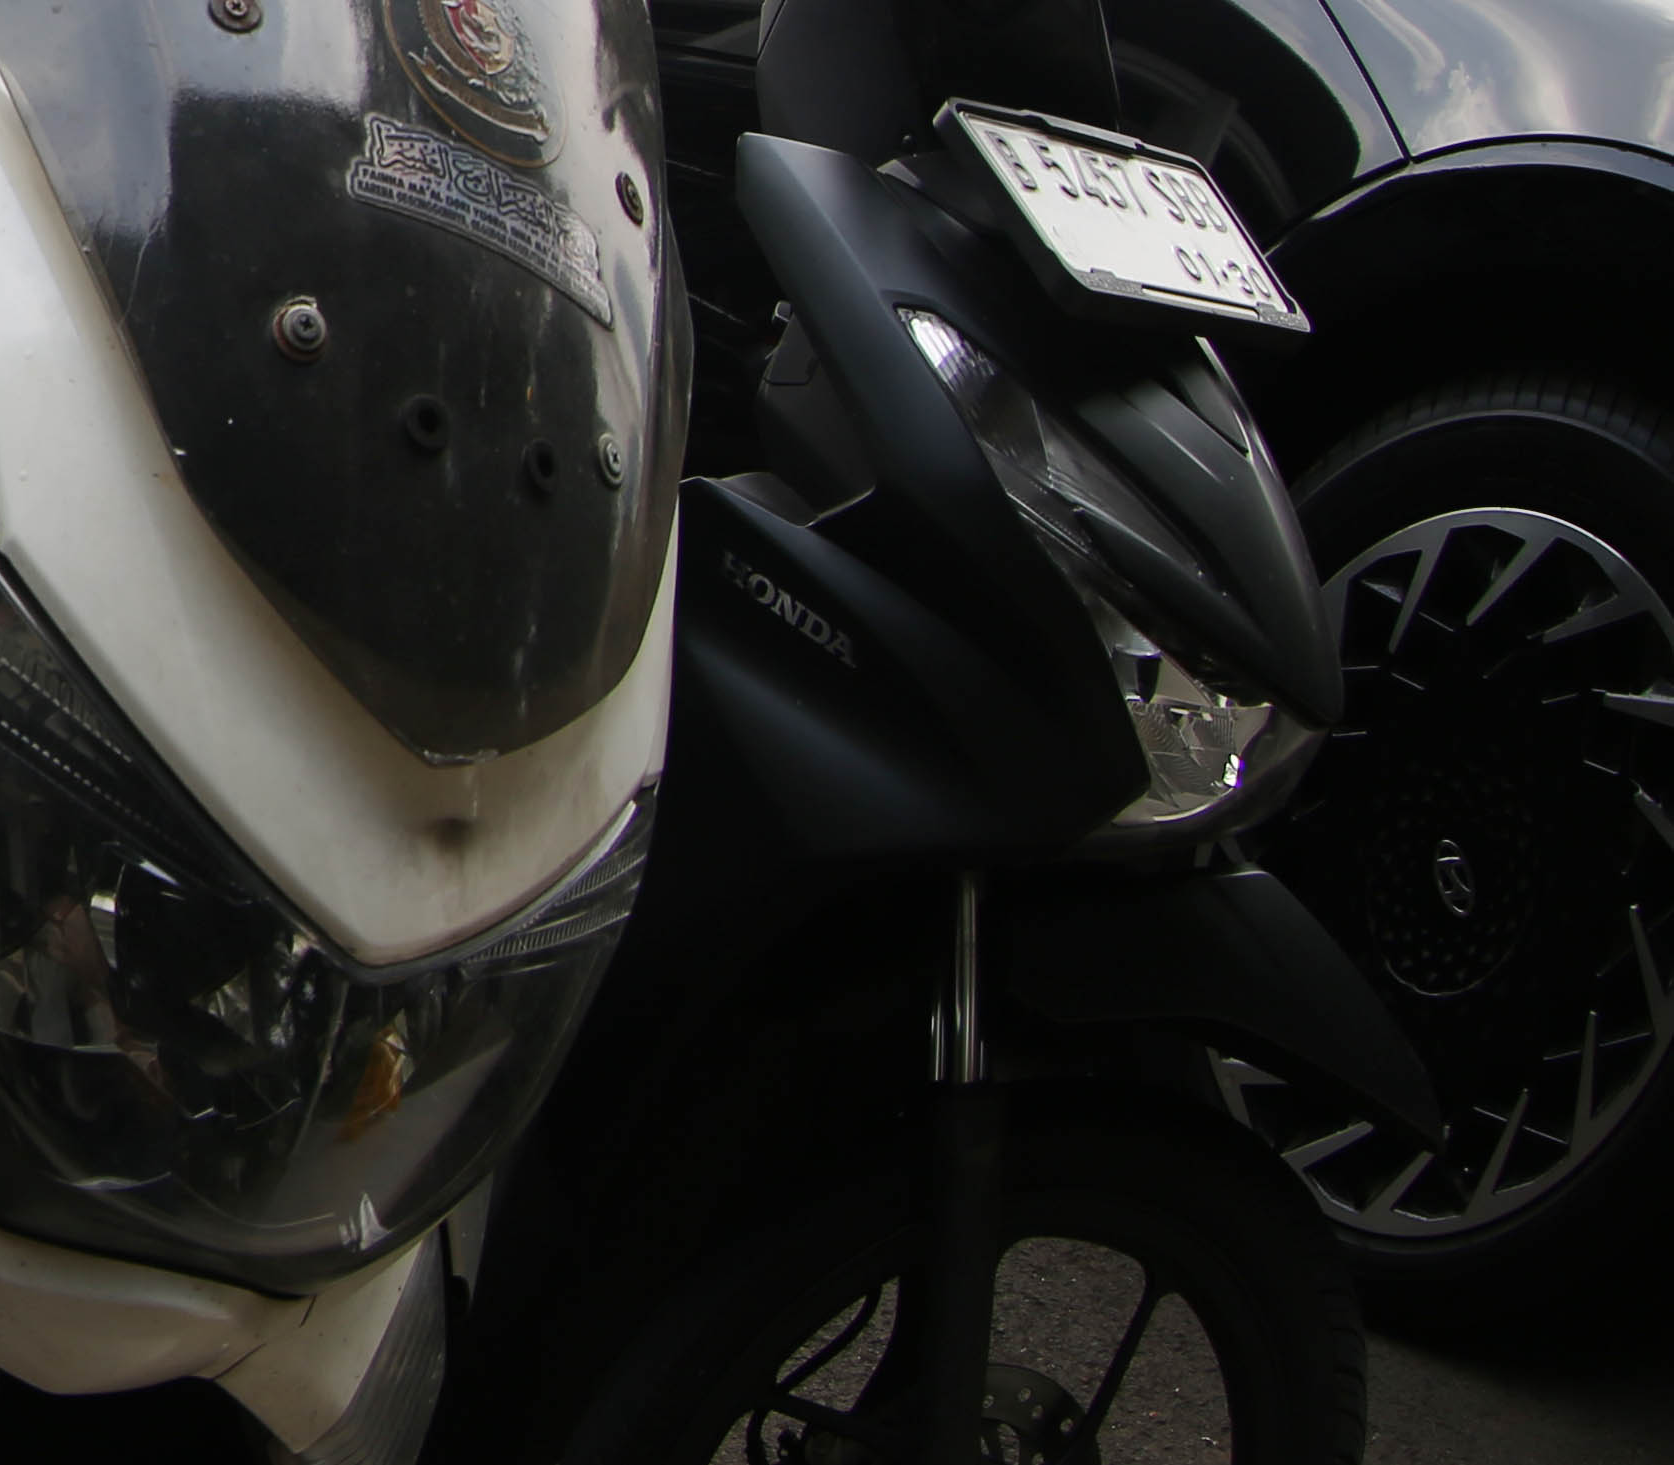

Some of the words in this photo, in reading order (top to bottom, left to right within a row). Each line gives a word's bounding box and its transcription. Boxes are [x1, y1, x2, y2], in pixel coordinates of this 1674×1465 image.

[984, 130, 1037, 192] B
[1024, 136, 1148, 216] 5457
[1140, 164, 1228, 234] SBB
[722, 550, 857, 669] HONDA
